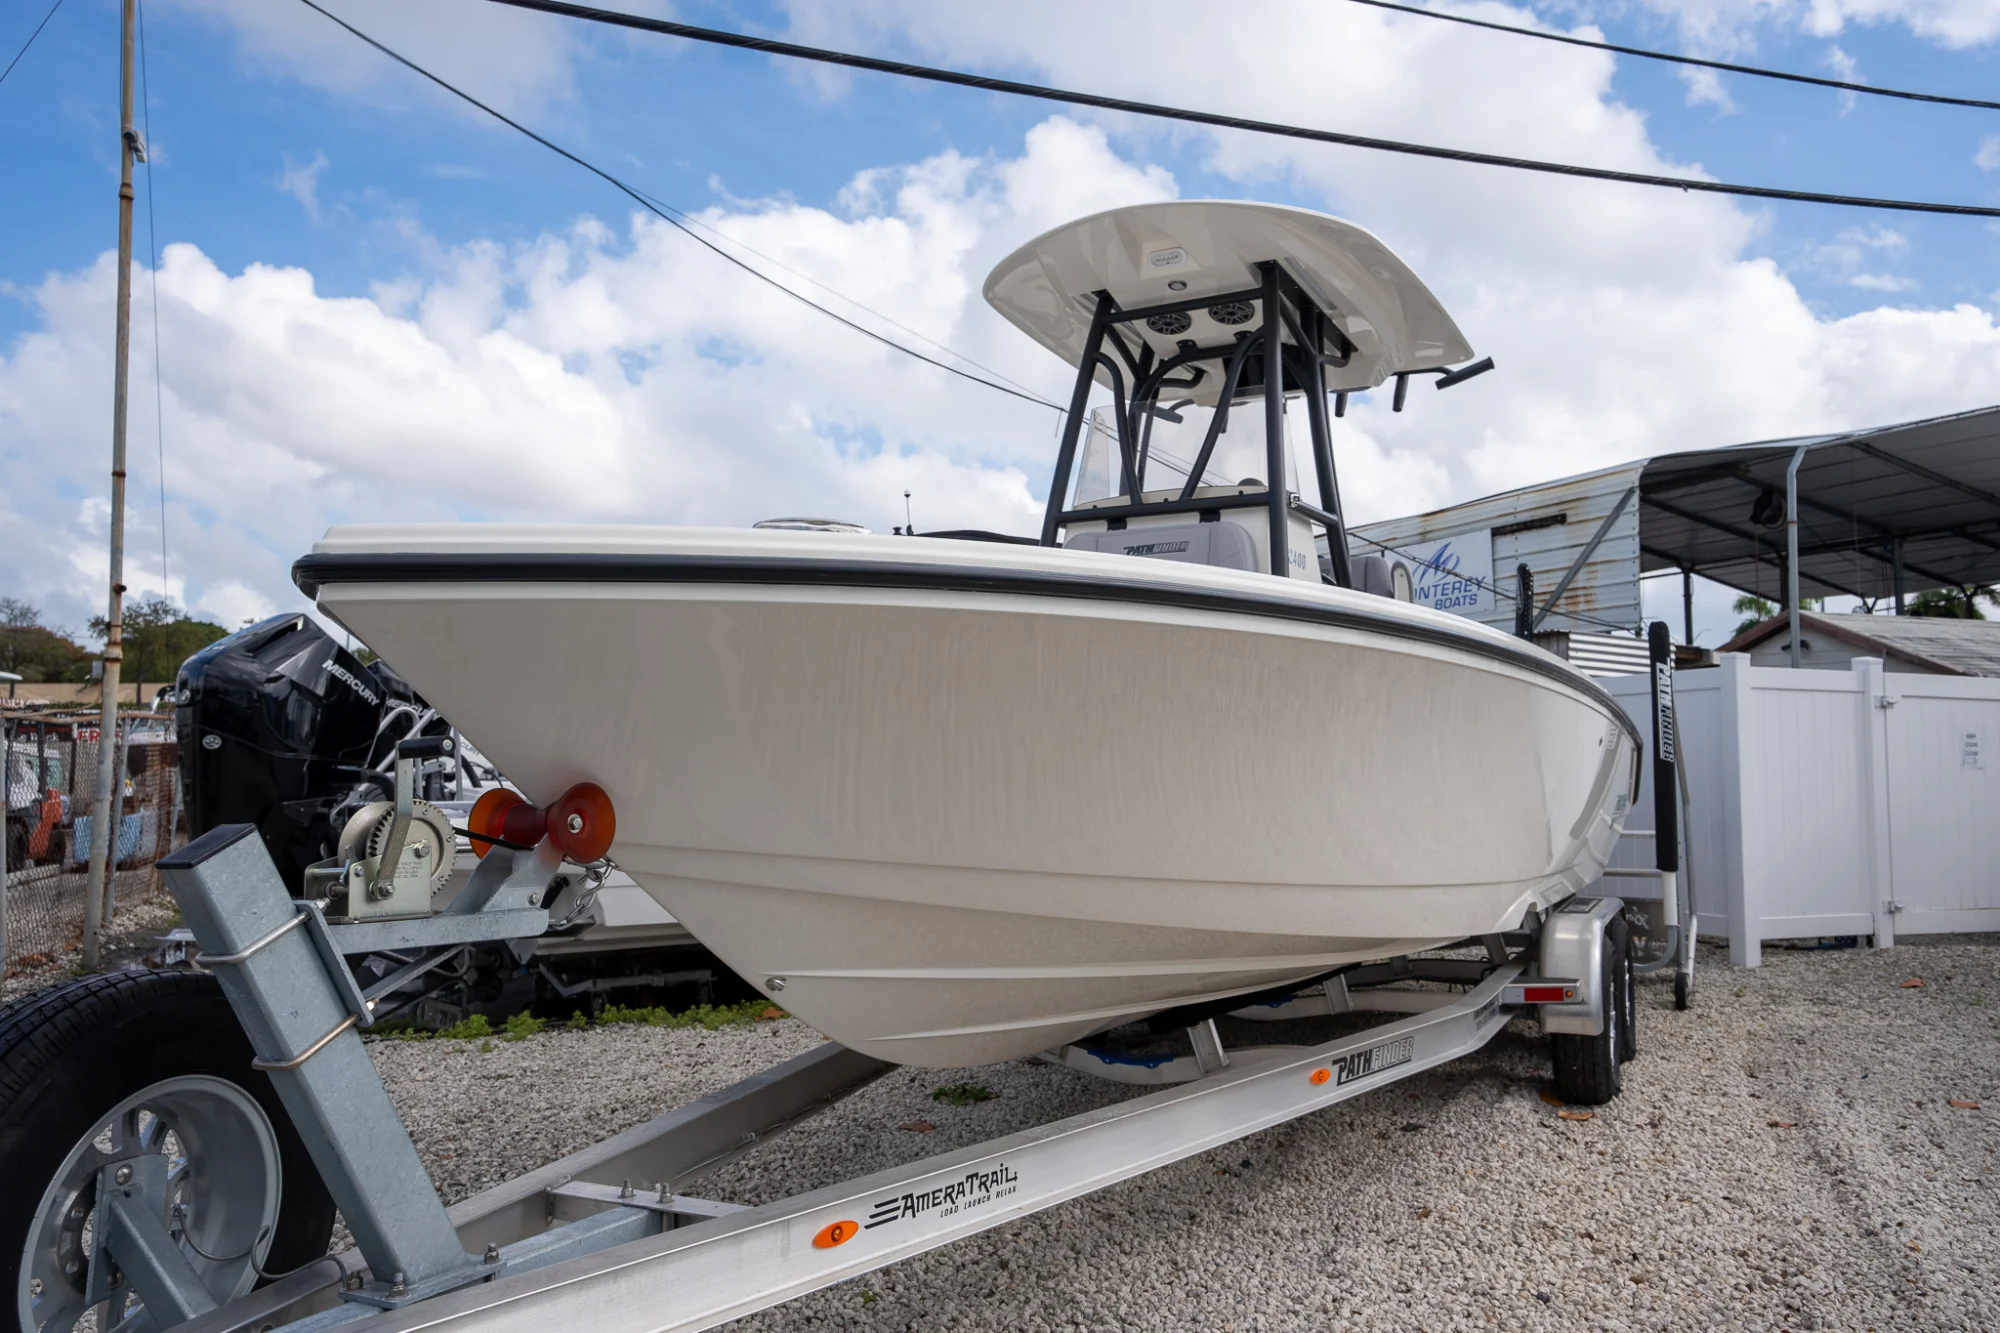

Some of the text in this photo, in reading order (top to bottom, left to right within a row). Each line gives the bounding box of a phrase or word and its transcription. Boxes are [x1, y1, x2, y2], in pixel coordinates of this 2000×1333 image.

[1414, 576, 1486, 600] NTEREY
[1434, 593, 1478, 610] BOATS
[322, 659, 380, 706] MERCURY
[1656, 657, 1675, 763] PATHFINDER
[1332, 1036, 1415, 1087] PATHFINDER
[940, 1185, 1017, 1218] LOAD LAUNCH RELAX
